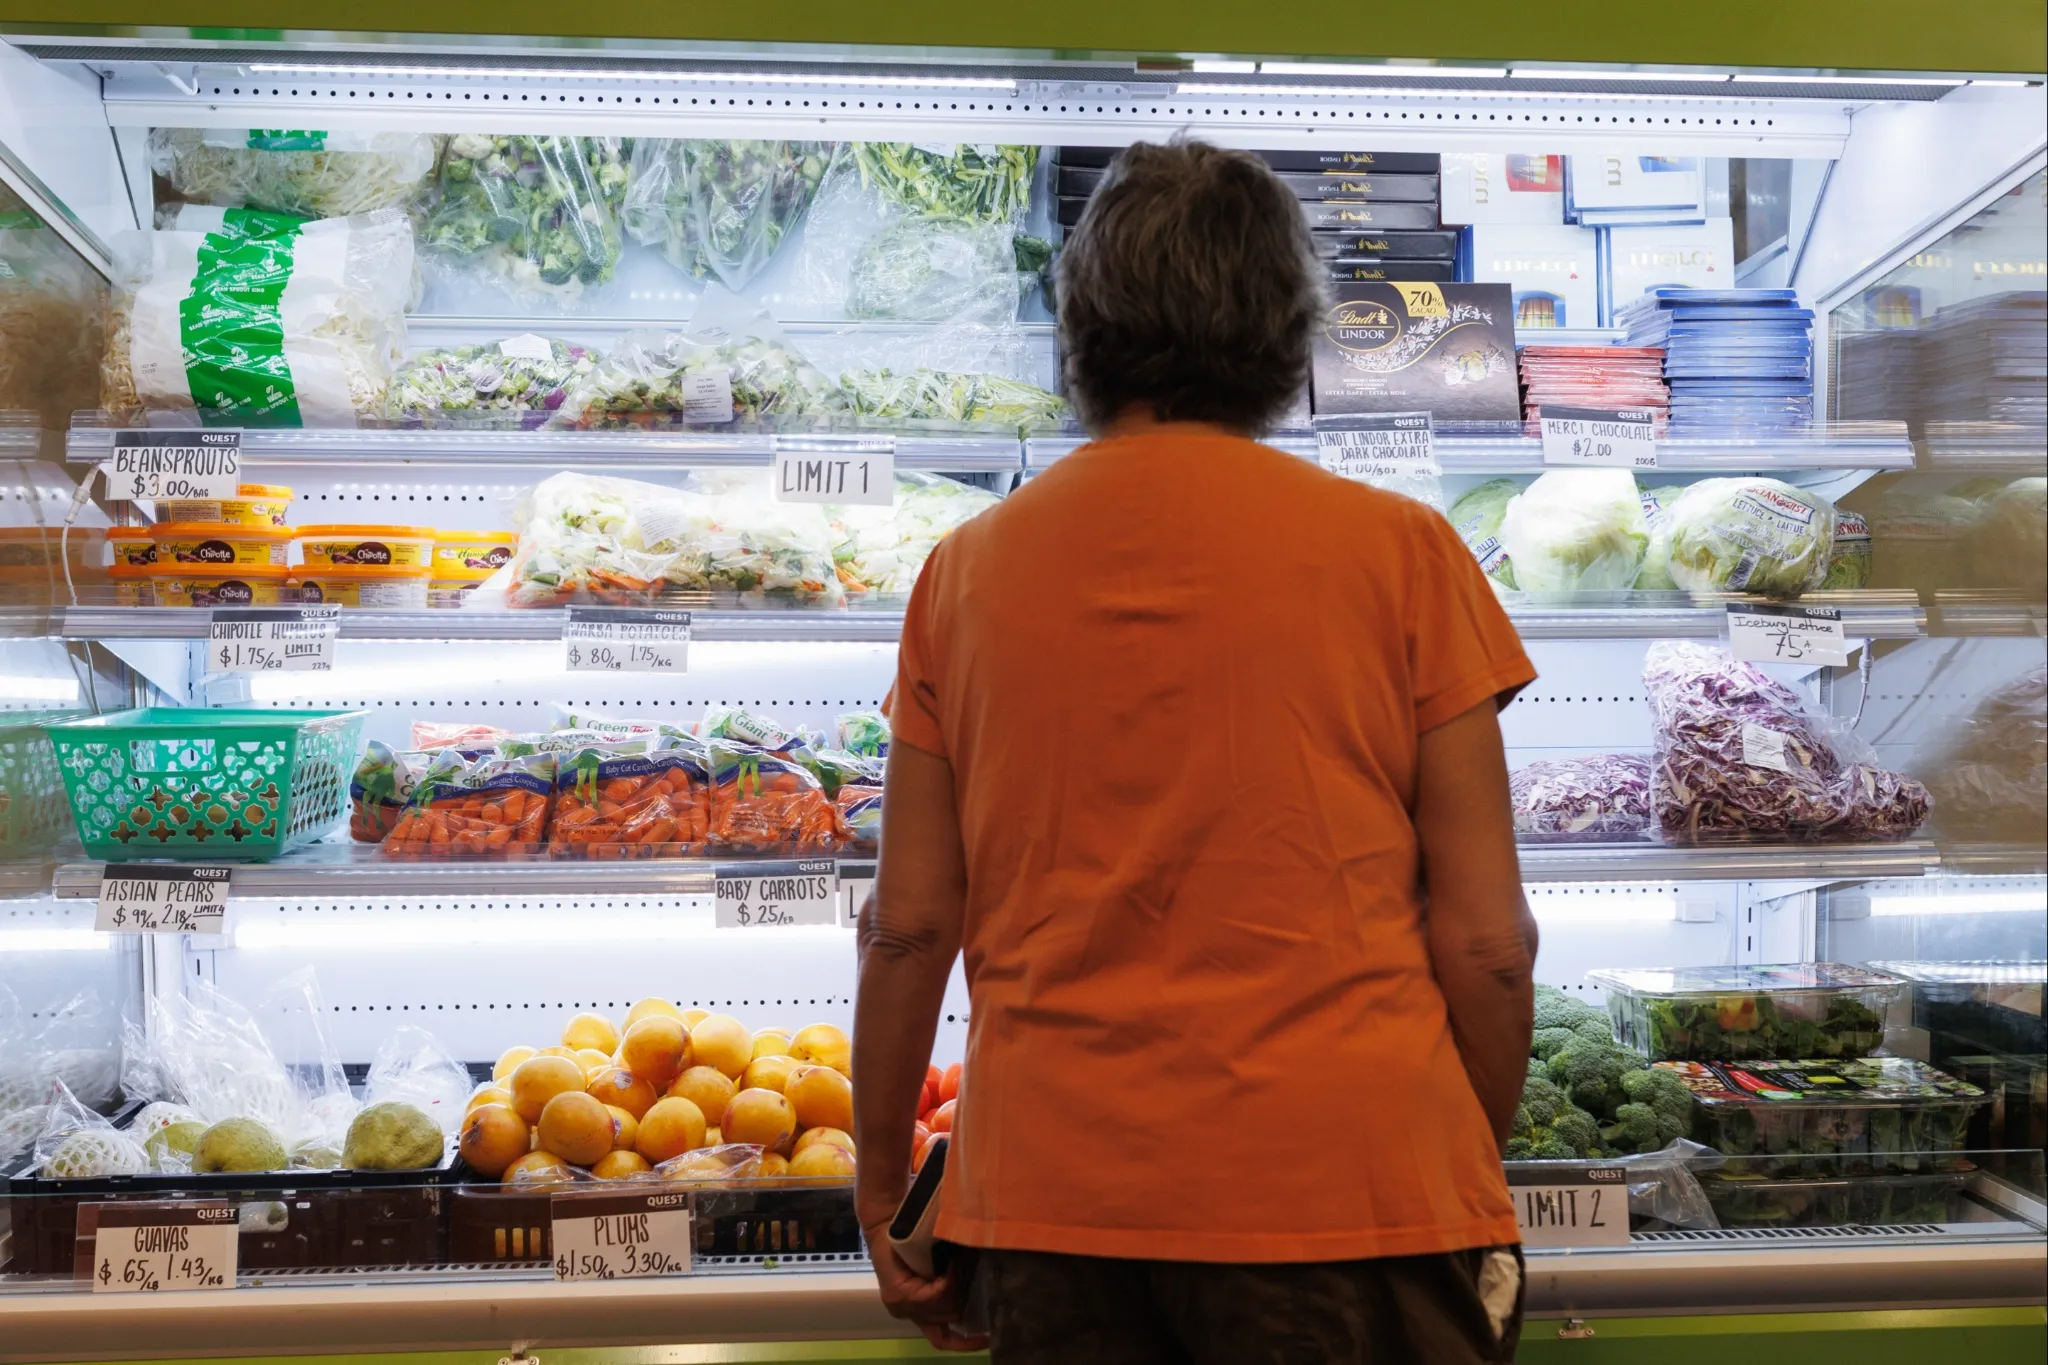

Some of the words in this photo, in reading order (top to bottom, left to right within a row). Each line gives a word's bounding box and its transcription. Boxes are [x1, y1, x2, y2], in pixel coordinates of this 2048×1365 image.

[1409, 290, 1443, 308] 70%
[1336, 310, 1379, 325] Lindt
[1410, 307, 1438, 315] CACAO
[1339, 328, 1386, 340] LINDOR
[1617, 411, 1649, 420] QUEST
[1394, 418, 1426, 428] QUEST
[1547, 420, 1584, 435] MERCI
[1591, 421, 1653, 441] CHOCOLATE
[202, 434, 236, 443] QUEST
[1318, 432, 1348, 448] LINDT
[1352, 431, 1391, 447] LINDOR
[1393, 430, 1430, 445] EXTRA
[1341, 446, 1370, 462] DARK
[1372, 444, 1430, 460] CHOCOLATE
[1572, 437, 1612, 457] $2.00
[116, 447, 238, 476] BEANSPROUTS
[782, 459, 851, 494] LIMIT
[859, 461, 869, 494] 1
[1732, 497, 1766, 521] LETTUCE
[1776, 520, 1805, 535] LAITUE
[200, 547, 231, 562] Chipotle
[357, 548, 389, 562] Chipotle
[301, 609, 336, 618] QUEST
[655, 612, 689, 621] QUEST
[1805, 607, 1837, 617] QUEST
[212, 622, 263, 640] CHIPOTLE
[570, 623, 613, 639] WARBA
[620, 624, 687, 641] POTATOES
[1733, 616, 1789, 635] Iceburg
[1788, 618, 1834, 633] Lettuce
[285, 643, 315, 655] LIMIT
[316, 643, 322, 653] 1
[586, 719, 629, 732] Green
[605, 764, 620, 776] Baby
[620, 763, 632, 773] Cut
[193, 868, 229, 878] QUEST
[799, 862, 832, 871] QUEST
[106, 880, 159, 902] ASIAN
[166, 881, 216, 903] PEARS
[717, 879, 752, 901] BABY
[759, 877, 828, 901] CARROTS
[194, 905, 218, 914] LIMIT
[1588, 1169, 1623, 1180] QUEST
[647, 1194, 684, 1207] QUEST
[197, 1208, 236, 1220] QUEST
[1590, 1189, 1607, 1228] 2
[594, 1213, 650, 1247] PLUMS
[134, 1226, 189, 1253] GUAVAS
